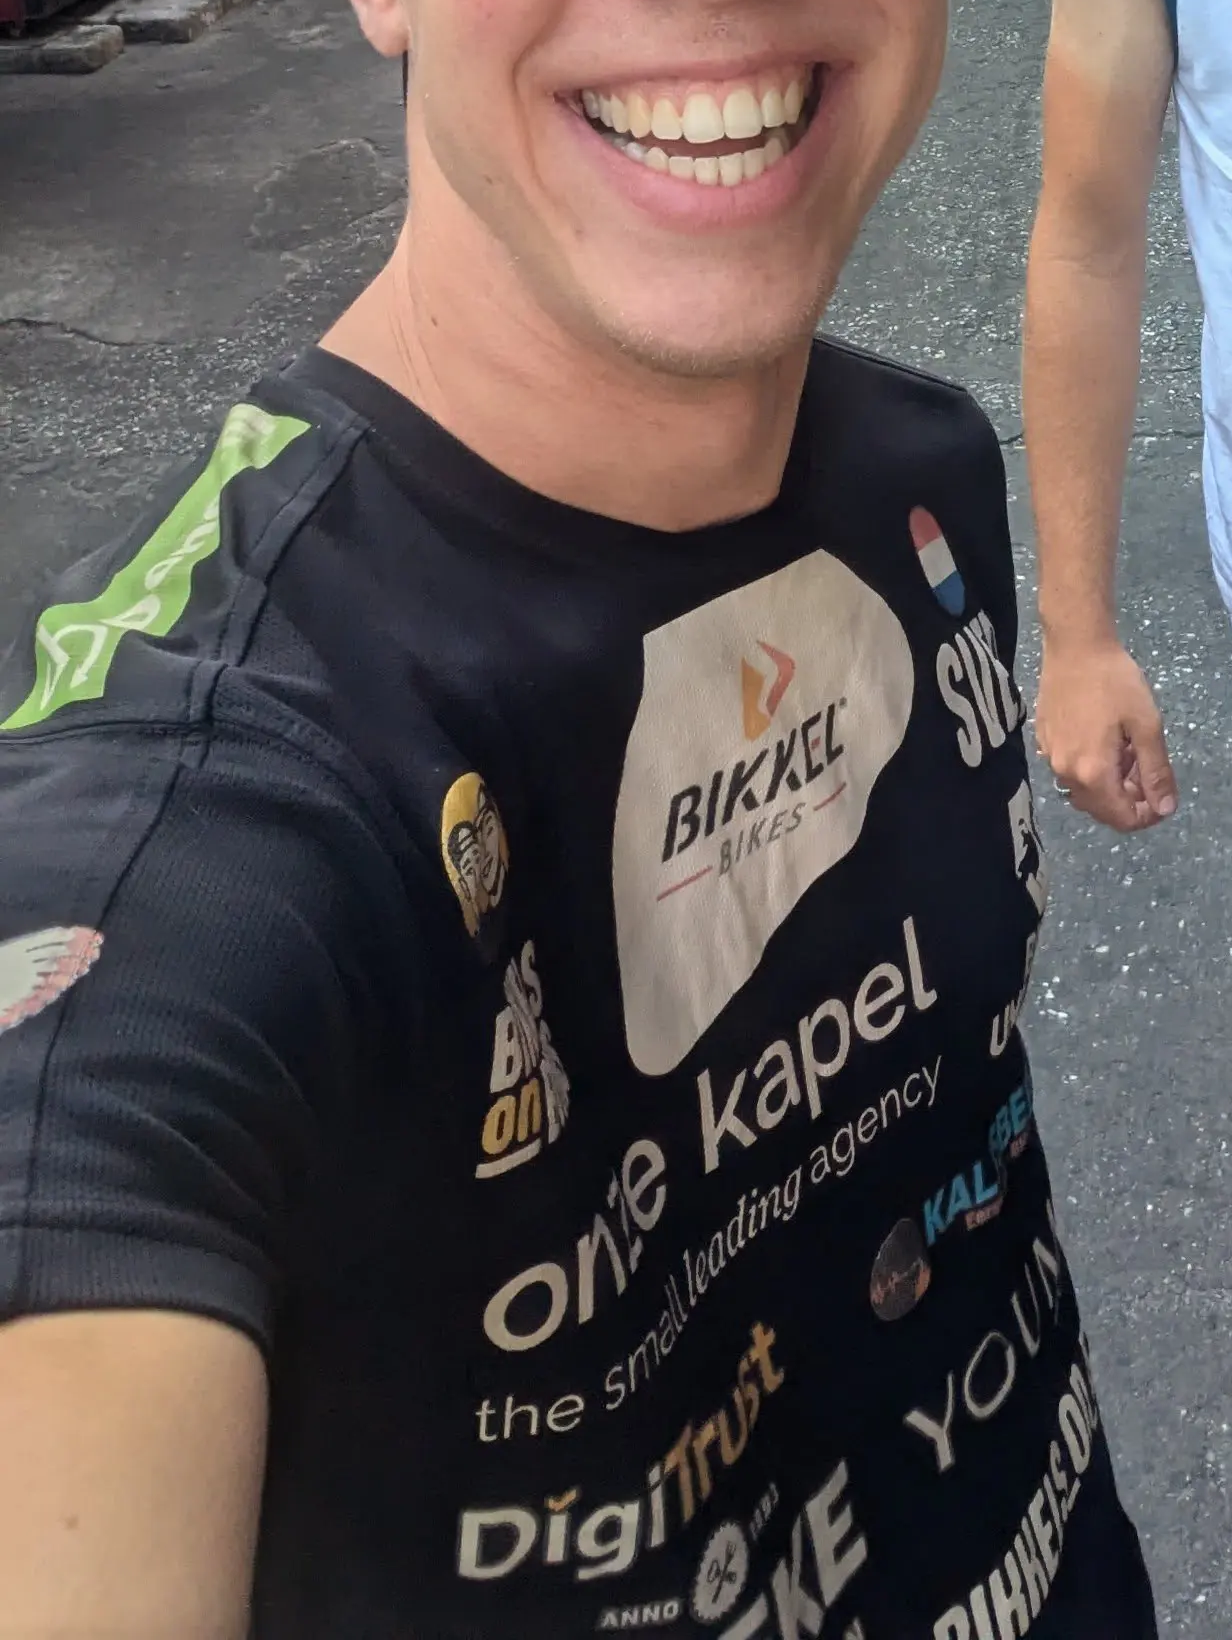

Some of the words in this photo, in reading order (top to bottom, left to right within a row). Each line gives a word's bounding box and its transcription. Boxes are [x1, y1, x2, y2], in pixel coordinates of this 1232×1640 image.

[662, 703, 845, 863] BIKKEL
[718, 802, 806, 877] BIKES
[482, 1078, 542, 1155] on
[698, 916, 938, 1174] kapel
[476, 1394, 585, 1443] the
[604, 1274, 688, 1410] small
[683, 1165, 802, 1307] leading
[810, 1054, 942, 1177] agency
[457, 1320, 784, 1580] DigiTrust
[601, 1600, 681, 1630] ANNO
